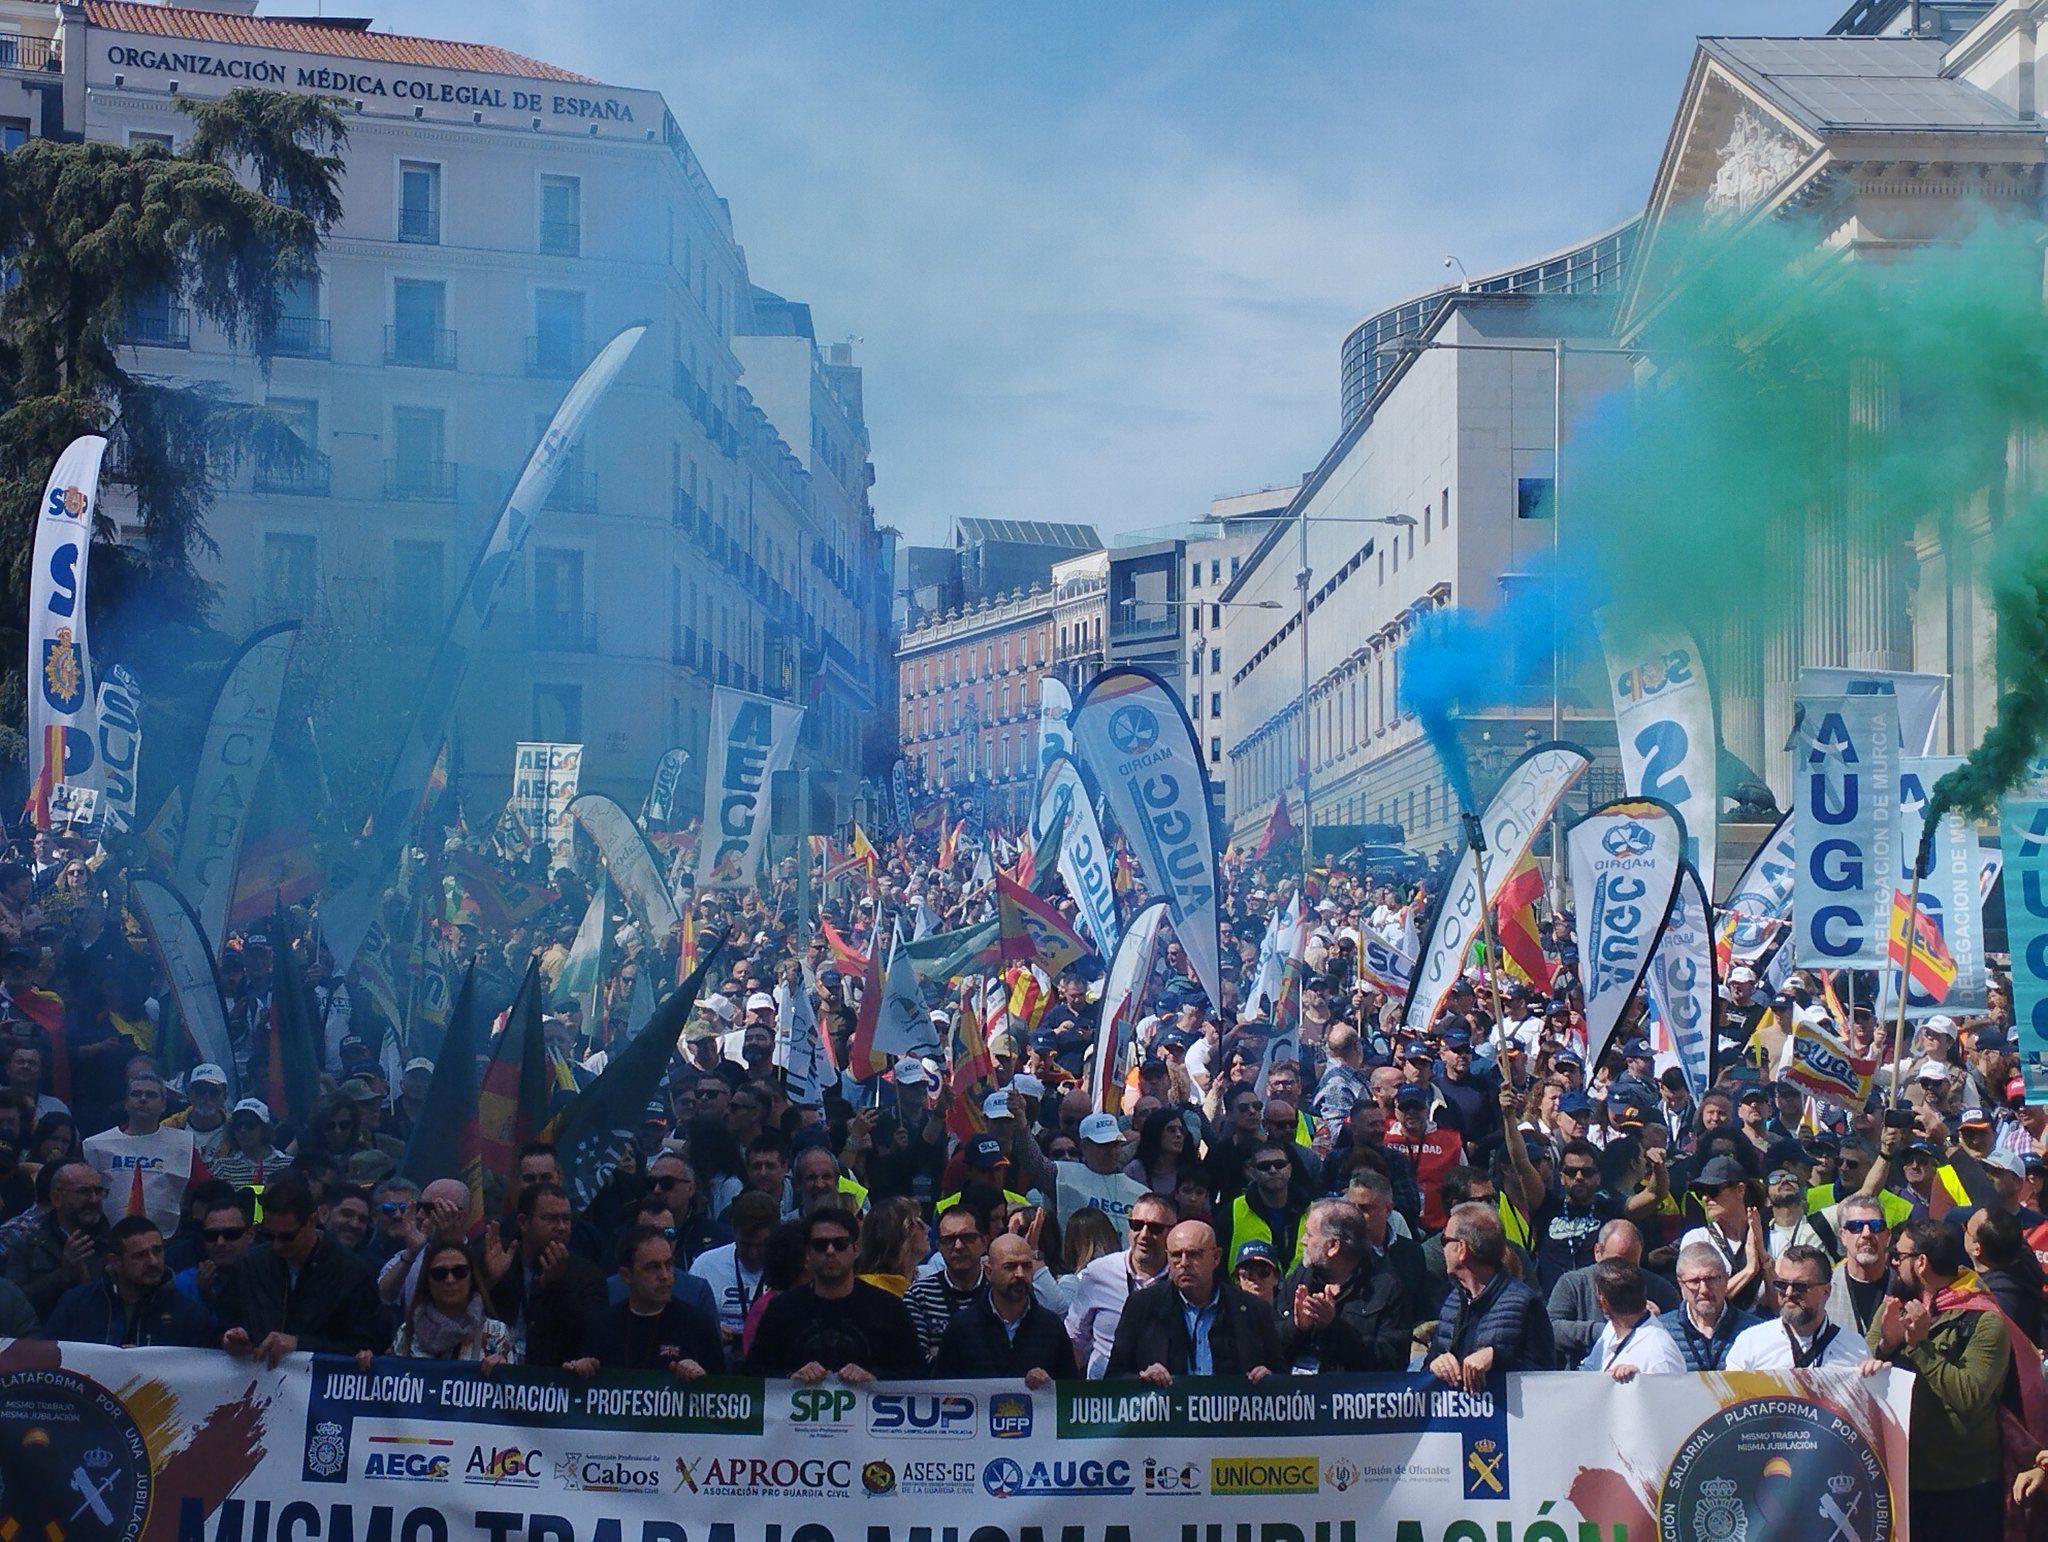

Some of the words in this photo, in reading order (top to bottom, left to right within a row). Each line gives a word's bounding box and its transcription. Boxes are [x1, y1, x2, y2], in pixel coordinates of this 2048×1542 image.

[108, 46, 285, 83] ORGANIZACIÓN
[297, 66, 388, 97] MÉDICA
[393, 79, 506, 109] COLEGIAL
[512, 91, 542, 112] DE
[552, 95, 635, 123] ESPAÑA
[1872, 713, 1888, 788] MURCIA
[1809, 713, 1864, 957] AUGC
[323, 1371, 424, 1403] JUBILACIÓN
[441, 1375, 569, 1413] EQUIPARACIÓN
[587, 1382, 686, 1417] PROFESIÓN
[687, 1393, 751, 1420] RIESGO
[789, 1389, 857, 1422] SPP
[872, 1396, 975, 1428] SUP
[1070, 1391, 1170, 1424] JUBILACIÓN
[1188, 1390, 1315, 1423] EQUIPARACIÓN
[1333, 1388, 1425, 1419] PROFESIÓN
[1432, 1389, 1494, 1418] RIESGO
[0, 1372, 84, 1394] LATAFORMA
[96, 1394, 122, 1419] POR
[126, 1427, 143, 1459] UNA
[993, 1417, 1029, 1431] UFP
[465, 1446, 543, 1477] AIGC
[1669, 1429, 1714, 1489] SALARIAL
[1724, 1402, 1818, 1426] PLATAFORMA
[1831, 1417, 1857, 1444] POR
[1861, 1450, 1881, 1480] UNA
[364, 1453, 450, 1476] AEGC
[582, 1462, 660, 1486] Cabos
[705, 1457, 850, 1487] APROGC
[1027, 1459, 1131, 1487] AUGC
